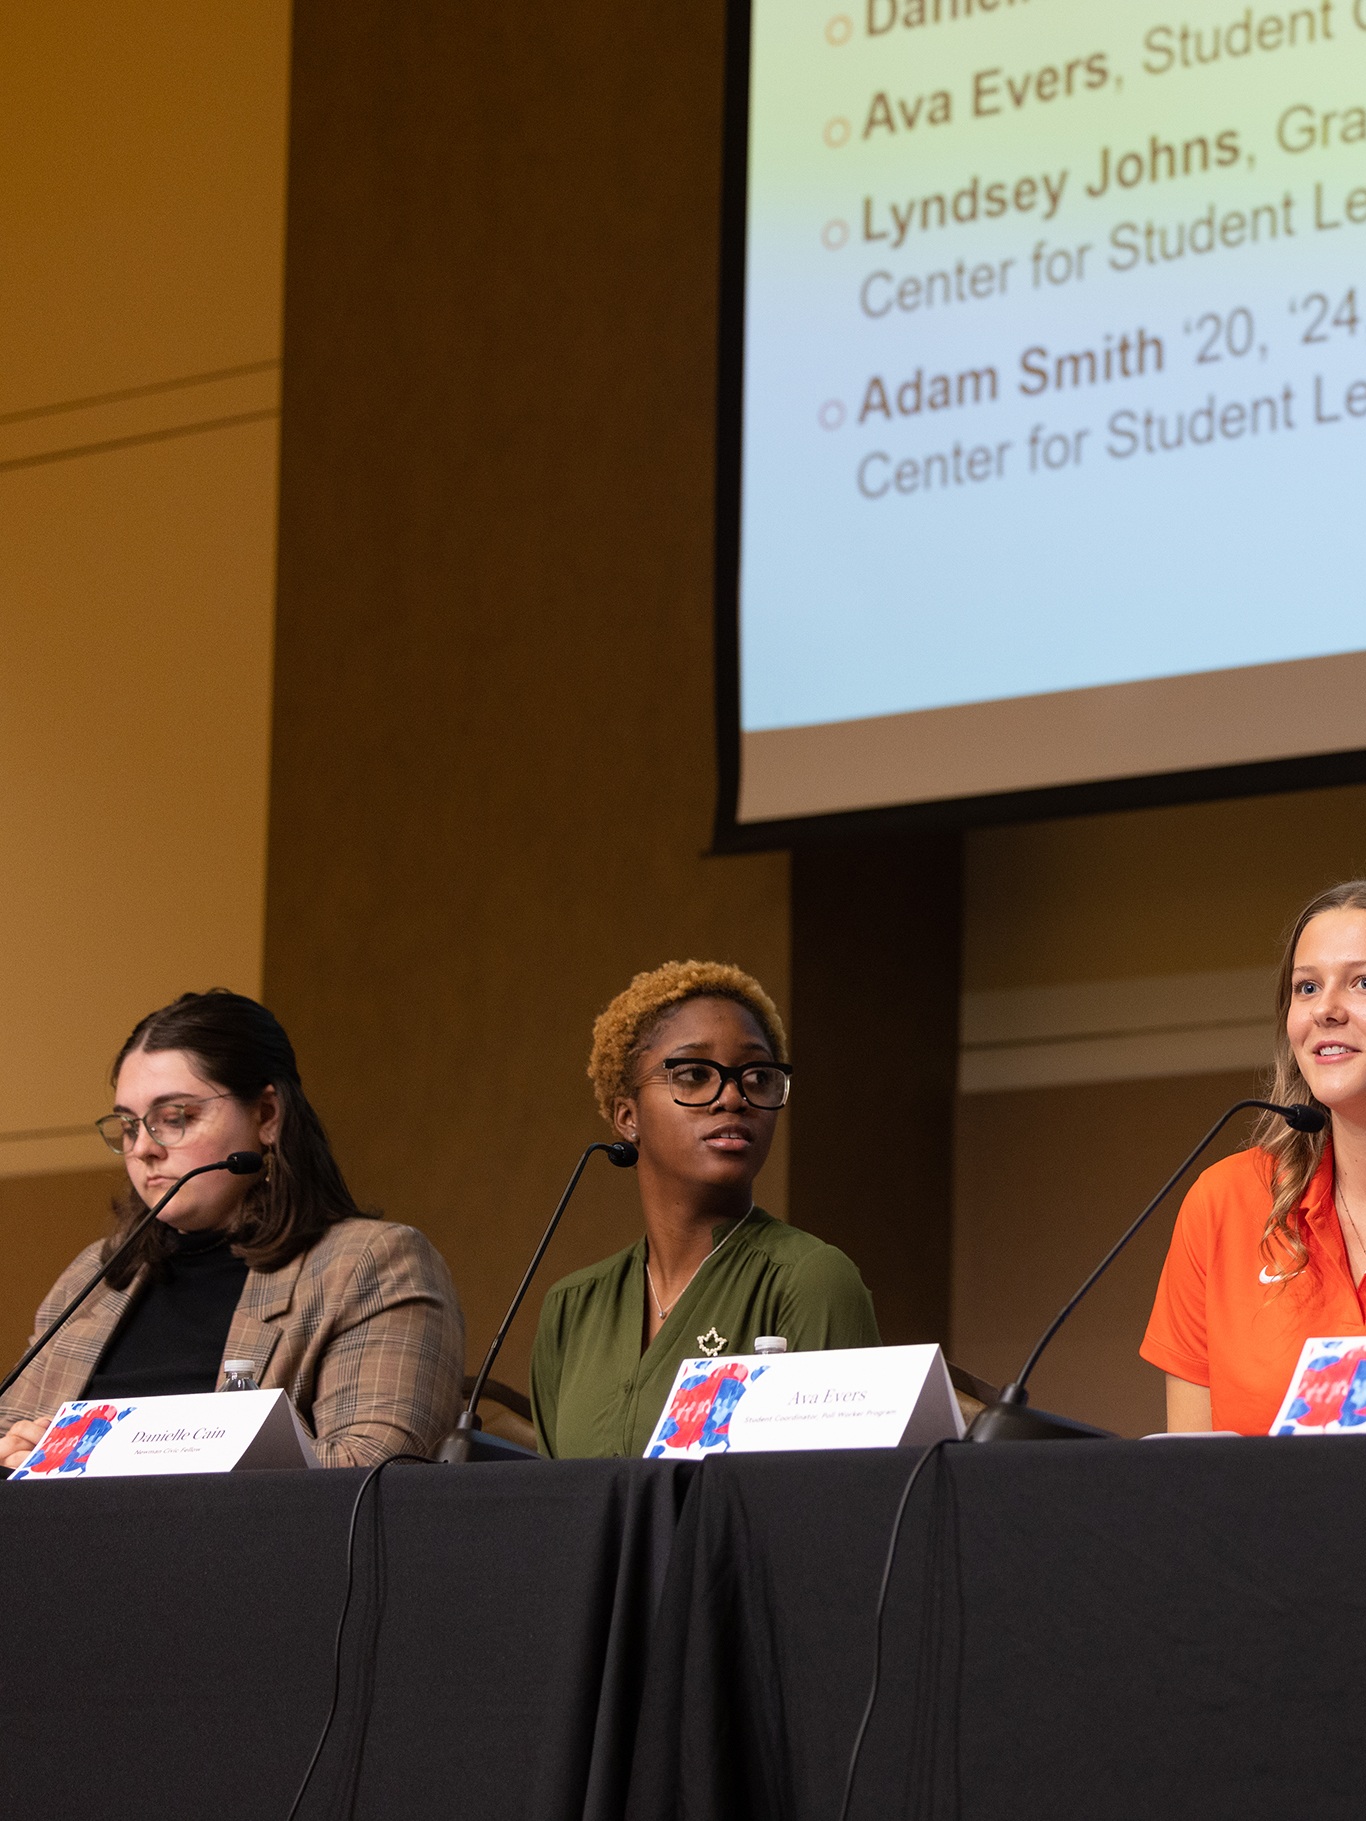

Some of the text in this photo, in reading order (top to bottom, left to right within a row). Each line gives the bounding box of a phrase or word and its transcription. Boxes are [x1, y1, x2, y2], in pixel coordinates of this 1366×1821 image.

[861, 89, 953, 141] Ava
[971, 51, 1123, 120] Evers,
[1142, 1, 1334, 76] Student
[861, 166, 1069, 250] Lyndsey
[1084, 128, 1257, 200] Johns,
[859, 255, 1015, 320] Center
[1030, 239, 1092, 290] for
[1108, 191, 1297, 275] Student
[857, 365, 999, 426] Adam
[1017, 327, 1166, 398] Smith
[856, 441, 1012, 500] Center
[1027, 423, 1091, 473] for
[1106, 387, 1297, 461] Student
[131, 1426, 226, 1443] Danielle Cain
[744, 1416, 773, 1424] Student
[788, 1388, 867, 1406] Ava Evers
